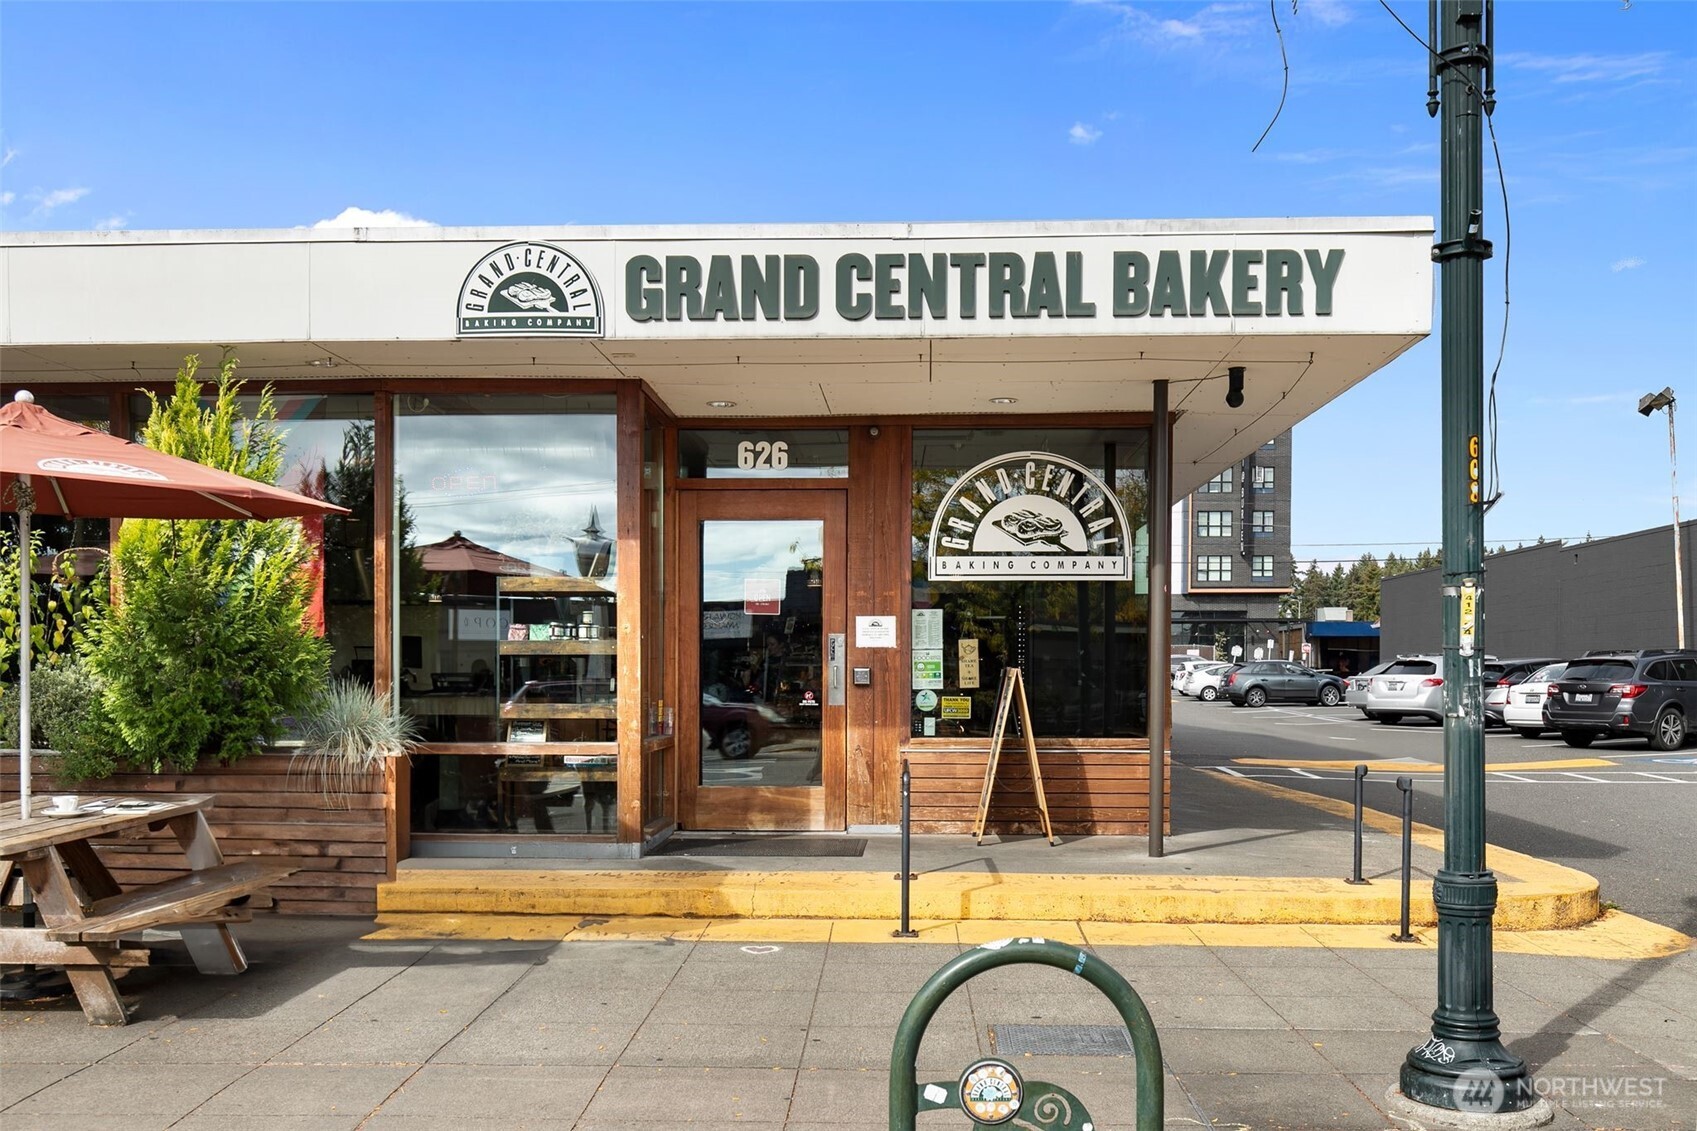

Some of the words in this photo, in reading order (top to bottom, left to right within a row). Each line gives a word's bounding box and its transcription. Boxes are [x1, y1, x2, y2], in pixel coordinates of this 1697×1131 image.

[625, 254, 820, 322] GRAND
[835, 250, 1097, 320] CENTRAL
[1112, 248, 1346, 318] BAKERY
[465, 319, 517, 328] BAKING
[527, 318, 592, 327] COMPANY
[737, 441, 789, 470] 626
[942, 560, 1014, 570] BAKING
[1030, 560, 1118, 570] COMPANY
